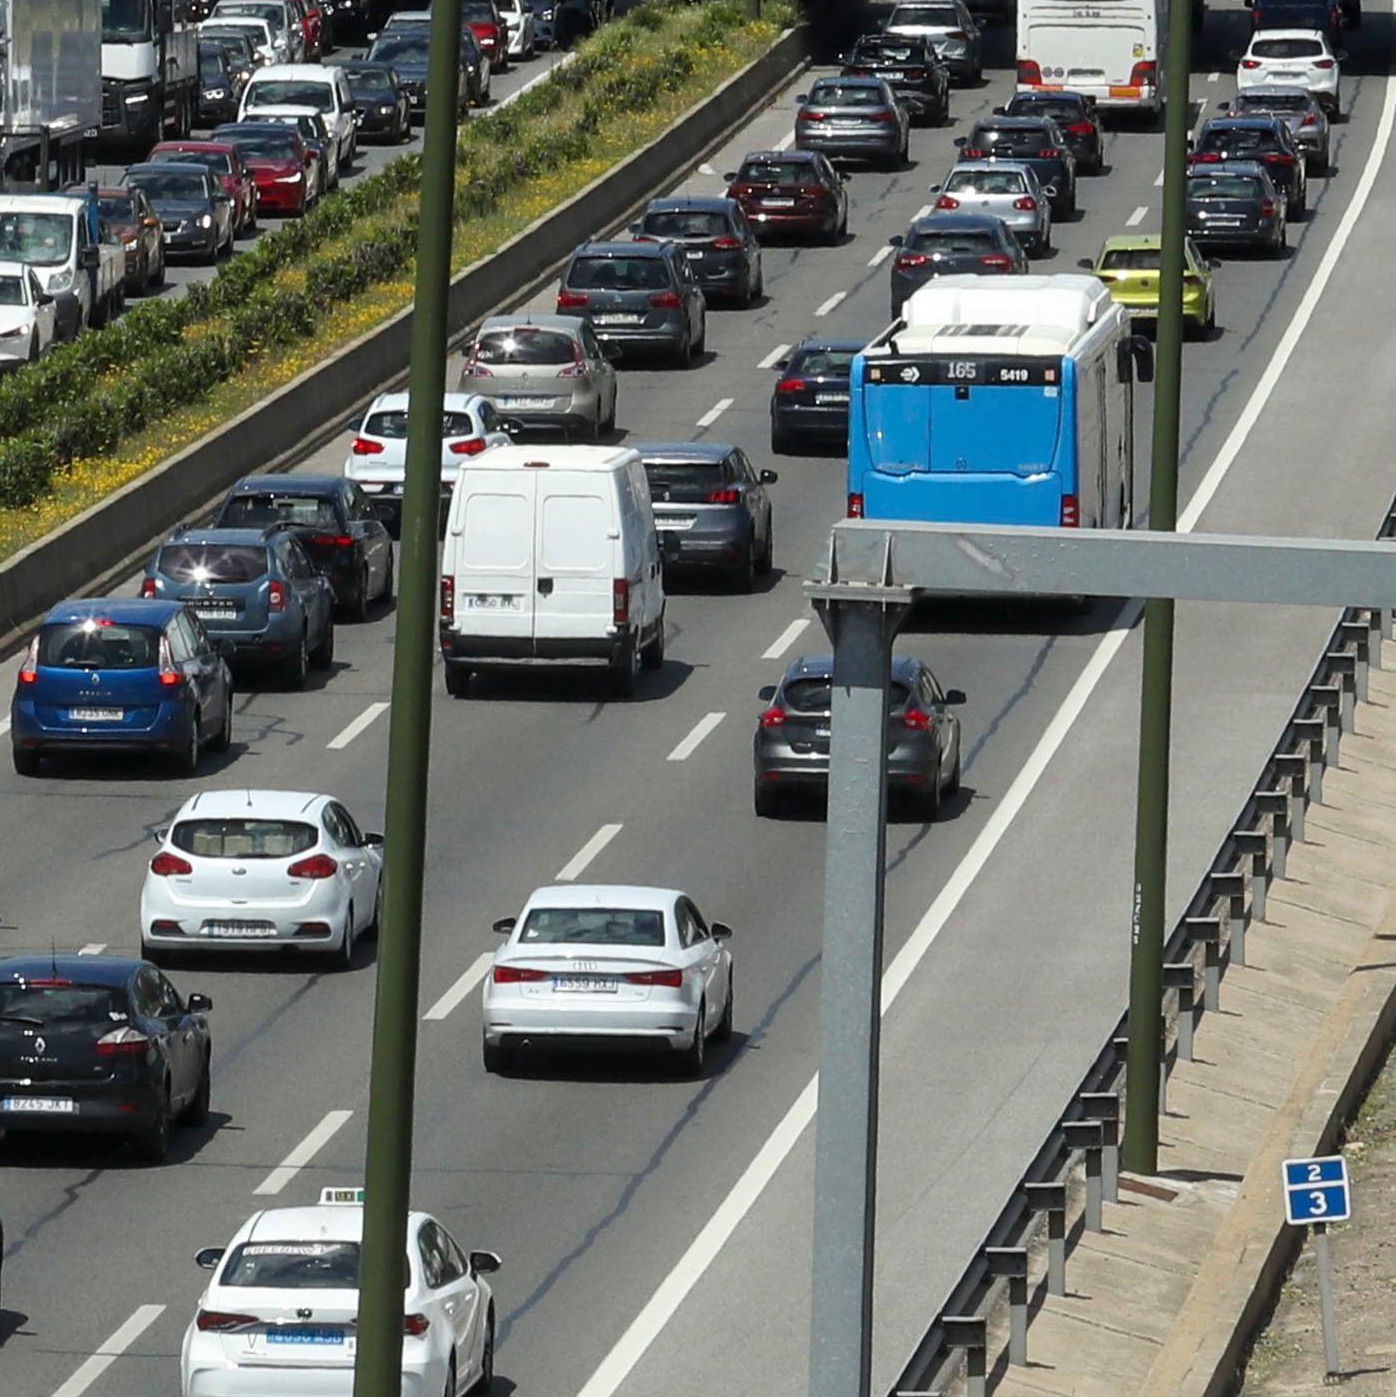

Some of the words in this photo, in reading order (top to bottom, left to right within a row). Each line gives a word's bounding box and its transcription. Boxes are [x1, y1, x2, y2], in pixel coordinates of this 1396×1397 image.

[947, 361, 977, 379] 165
[1000, 369, 1029, 381] 5419
[1307, 1164, 1322, 1181] 2
[1308, 1192, 1329, 1215] 3
